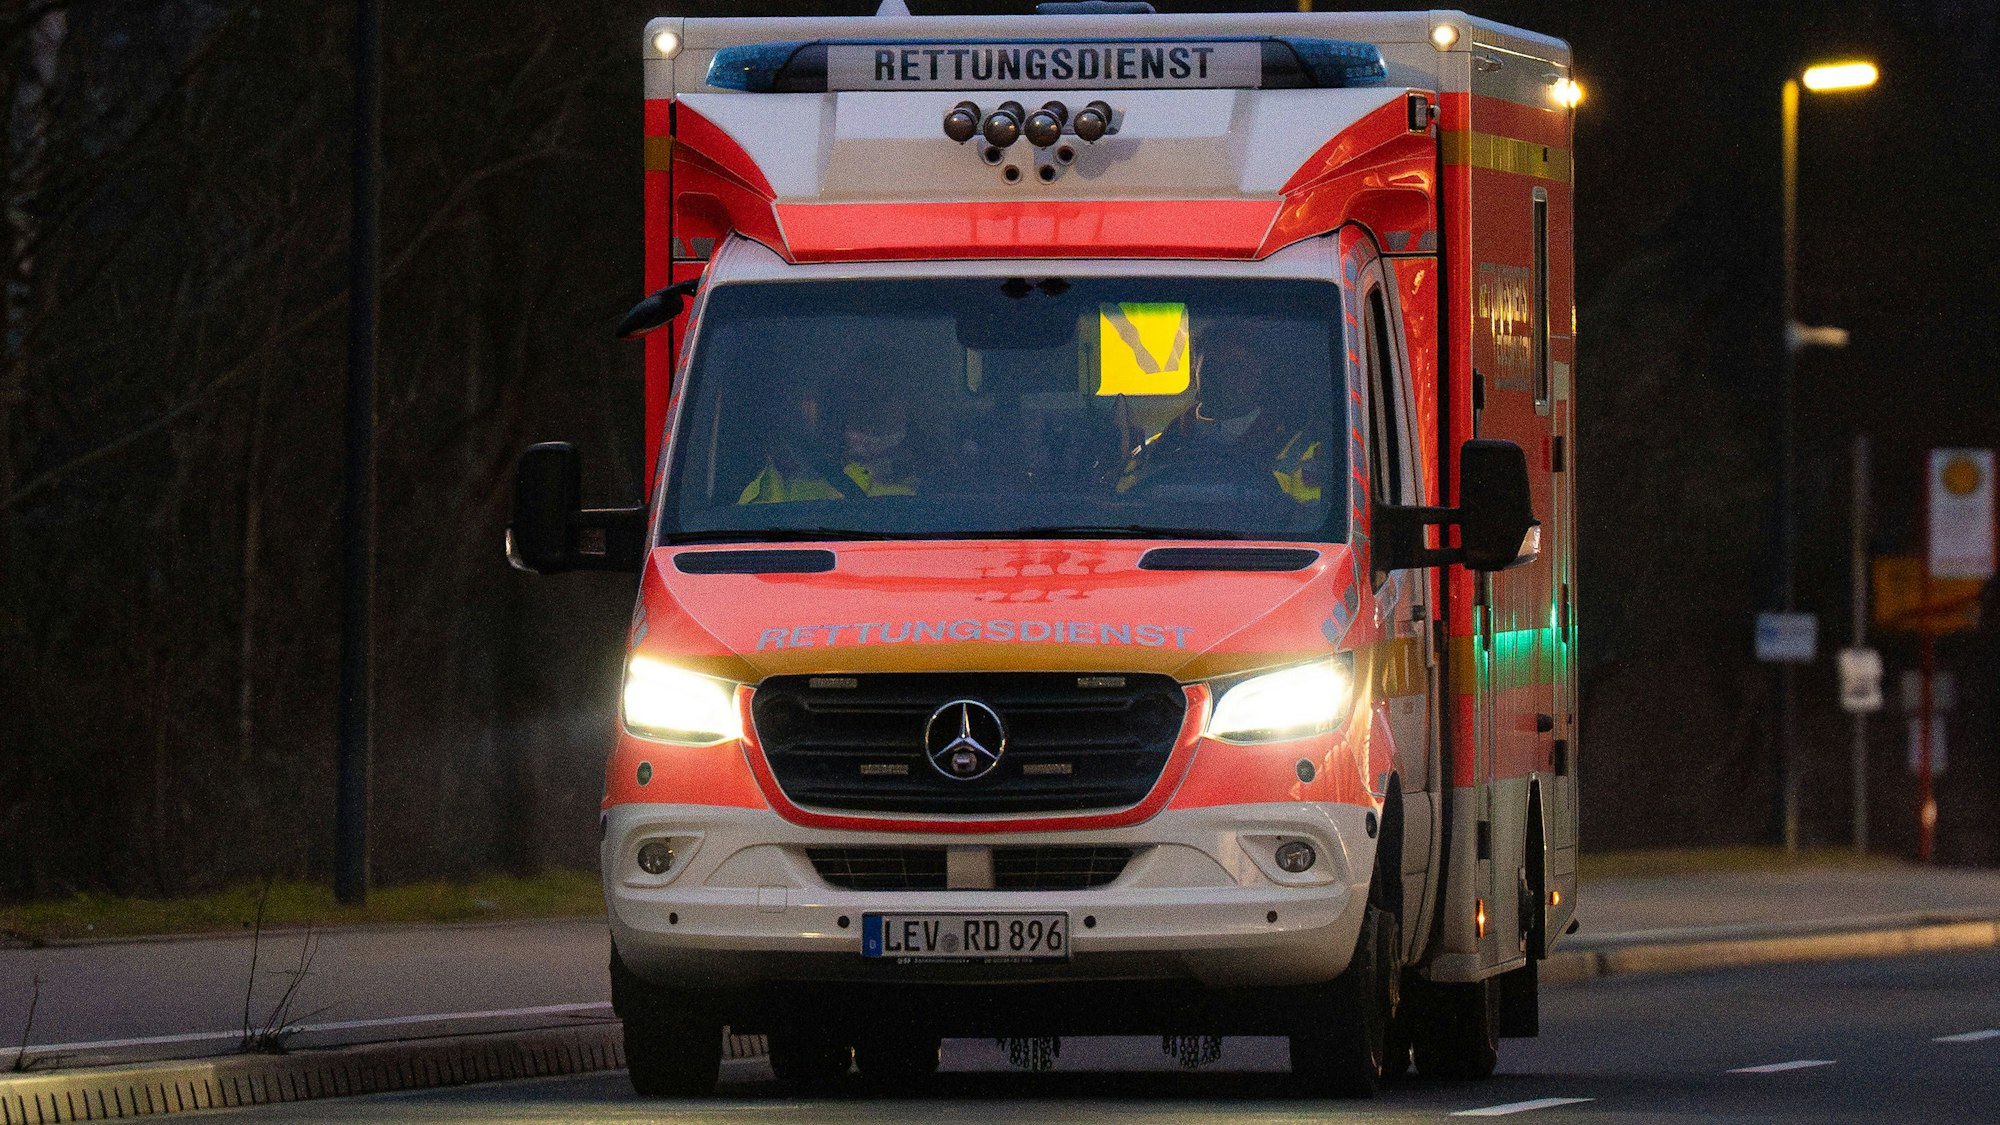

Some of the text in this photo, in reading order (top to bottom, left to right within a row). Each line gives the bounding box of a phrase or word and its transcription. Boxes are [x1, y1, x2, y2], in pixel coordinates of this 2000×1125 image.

[874, 48, 1214, 81] RETTUNGSDIENST
[756, 619, 1195, 650] RETTUNGSDIENST
[884, 919, 1062, 951] LEV RD 896
